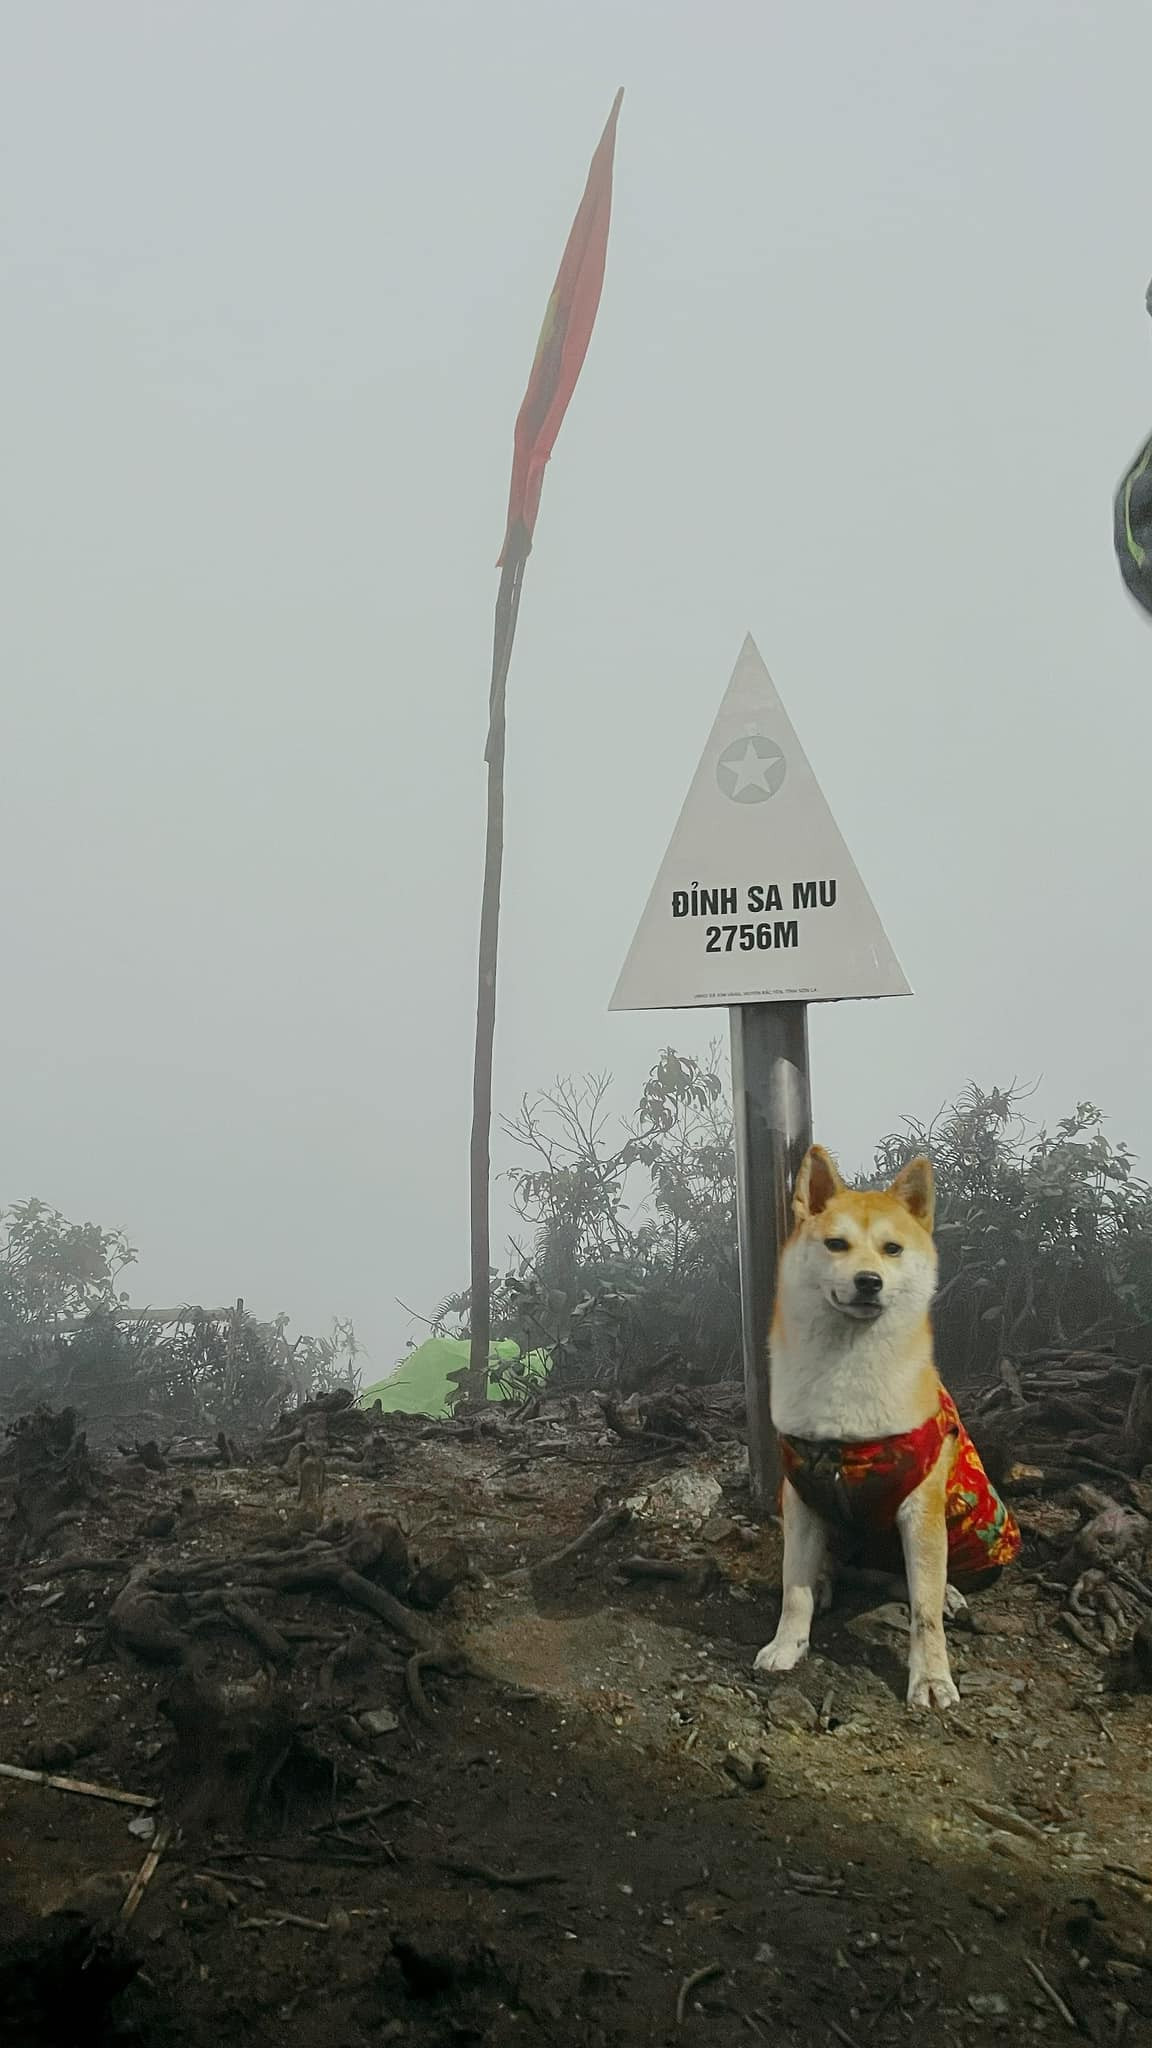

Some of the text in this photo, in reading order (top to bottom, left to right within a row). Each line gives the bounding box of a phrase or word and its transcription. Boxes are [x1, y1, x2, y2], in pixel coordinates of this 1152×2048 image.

[672, 879, 837, 918] ĐỈNH SA MU
[705, 920, 799, 953] 2756M
